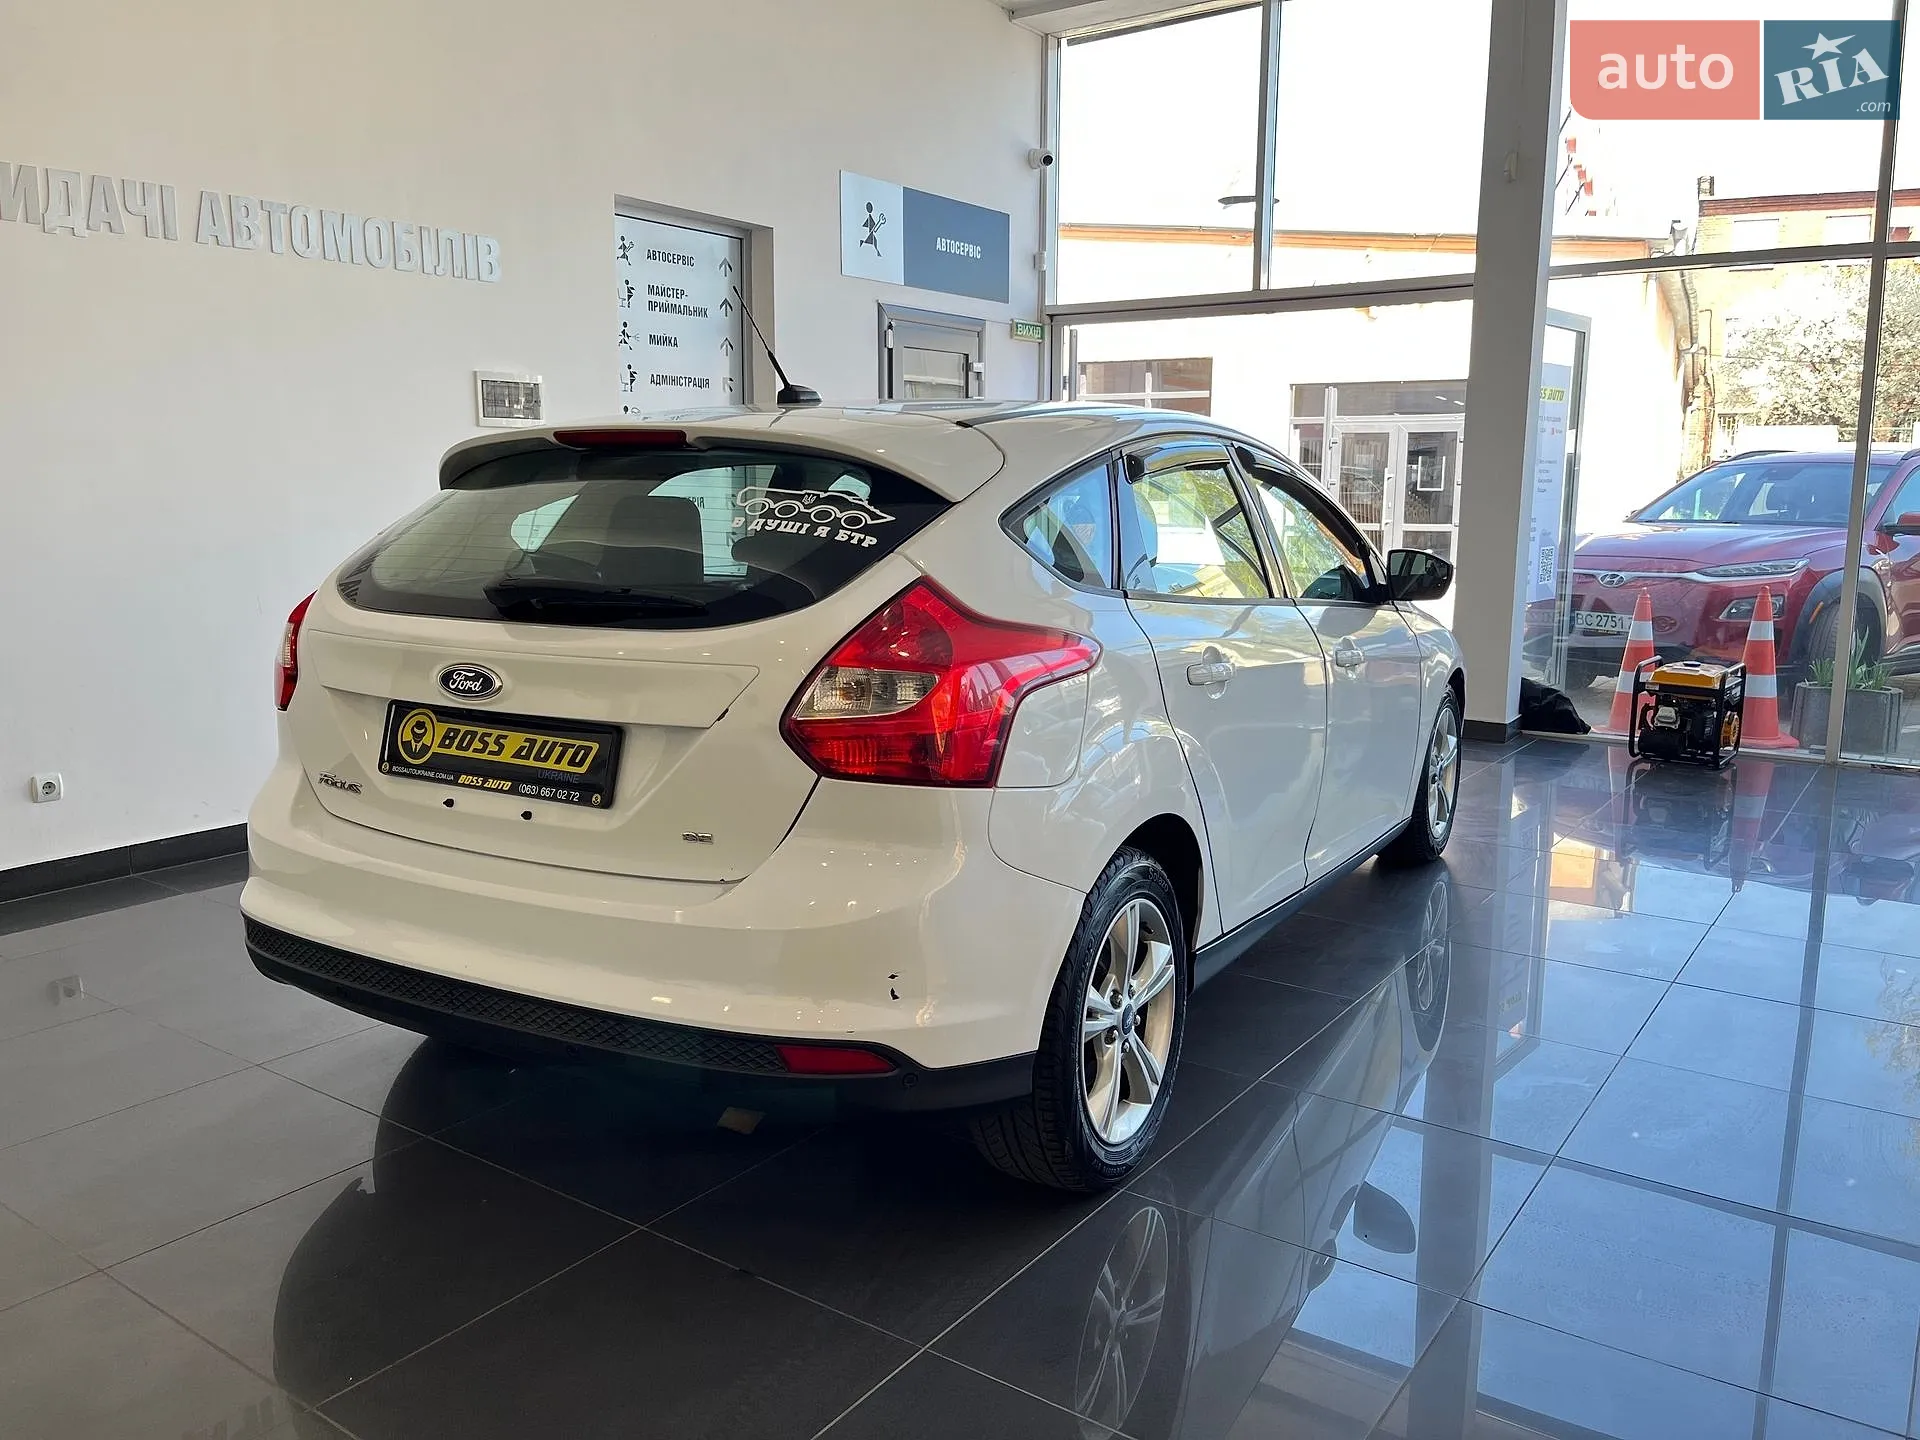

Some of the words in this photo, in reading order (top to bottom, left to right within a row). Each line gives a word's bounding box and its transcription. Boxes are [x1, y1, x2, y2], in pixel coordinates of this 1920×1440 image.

[195, 189, 500, 283] АВТОМОБІЛІВ
[936, 237, 981, 259] АВТОСЕРВІС
[646, 248, 695, 267] АВТОСЕРВІС
[647, 283, 688, 300] МАЙСТЕР-
[647, 300, 708, 318] ПРИЙМАЛЬНИК
[1017, 323, 1041, 338] ВИХІД
[648, 333, 679, 348] МИЙКА
[650, 373, 710, 389] АДМІНІСТРАЦІЯ
[747, 518, 811, 534] ДУШІ
[813, 525, 831, 538] Я
[834, 529, 878, 548] БТР
[1575, 612, 1593, 627] BC
[449, 670, 484, 692] Ford
[437, 727, 508, 757] BOSS
[511, 737, 592, 768] AUTO
[537, 769, 580, 784] UKRAINE
[457, 774, 484, 787] BOSS
[485, 778, 512, 791] AUTO
[518, 783, 539, 796] (063)
[540, 786, 556, 799] 667
[556, 790, 567, 801] 02
[569, 791, 580, 802] 72
